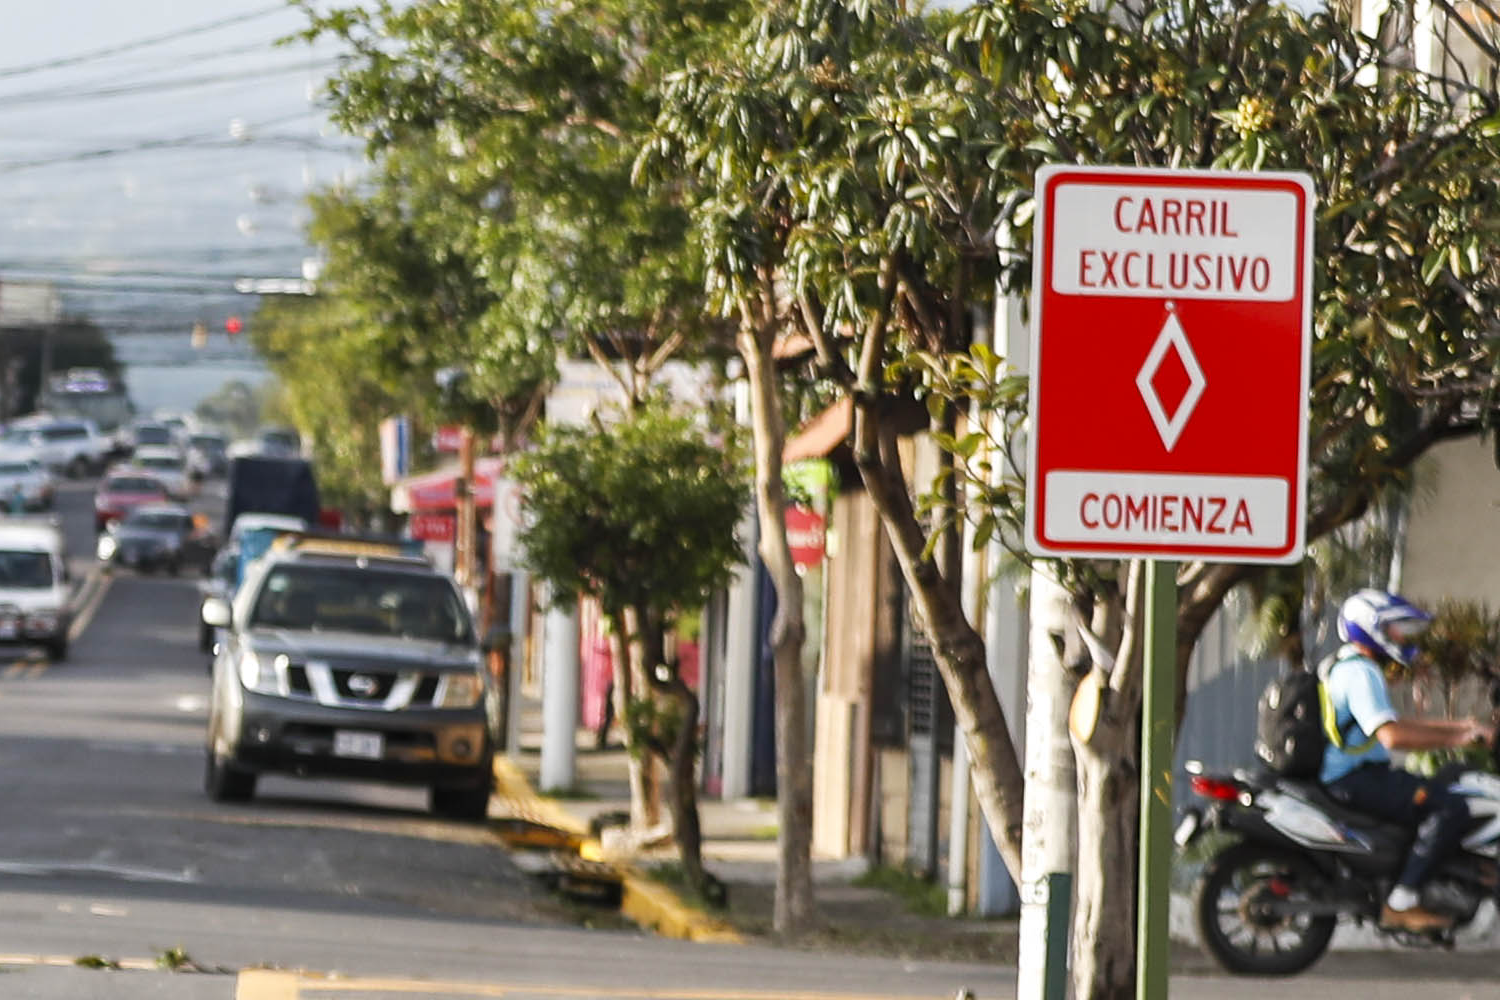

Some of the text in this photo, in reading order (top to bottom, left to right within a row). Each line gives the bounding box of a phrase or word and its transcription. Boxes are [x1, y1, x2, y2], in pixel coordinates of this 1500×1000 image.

[1113, 195, 1239, 239] CARRIL
[1078, 249, 1271, 293] EXCLUSIVO
[1079, 491, 1254, 536] COMIENZA
